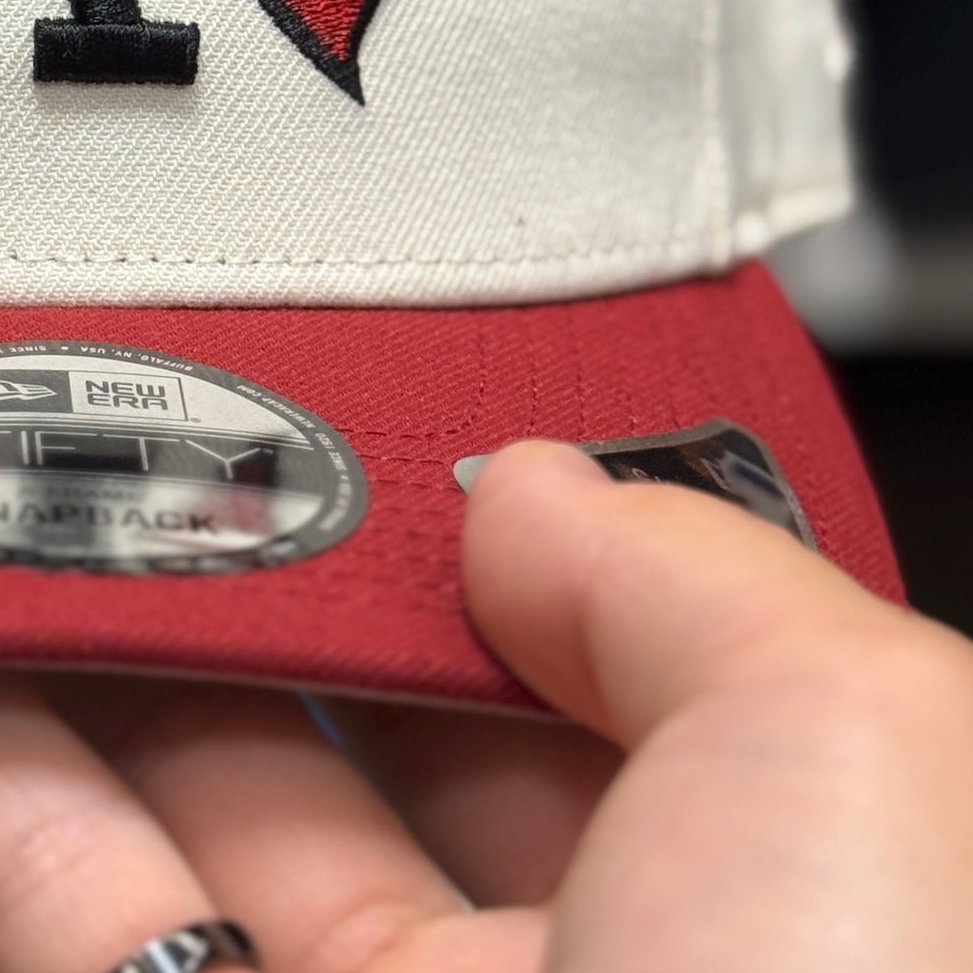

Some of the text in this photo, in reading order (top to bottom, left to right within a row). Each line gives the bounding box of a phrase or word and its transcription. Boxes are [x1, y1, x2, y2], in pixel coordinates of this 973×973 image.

[9, 345, 47, 354] SINCE
[80, 346, 106, 355] USA
[85, 379, 166, 398] NEW
[87, 393, 169, 411] ERA
